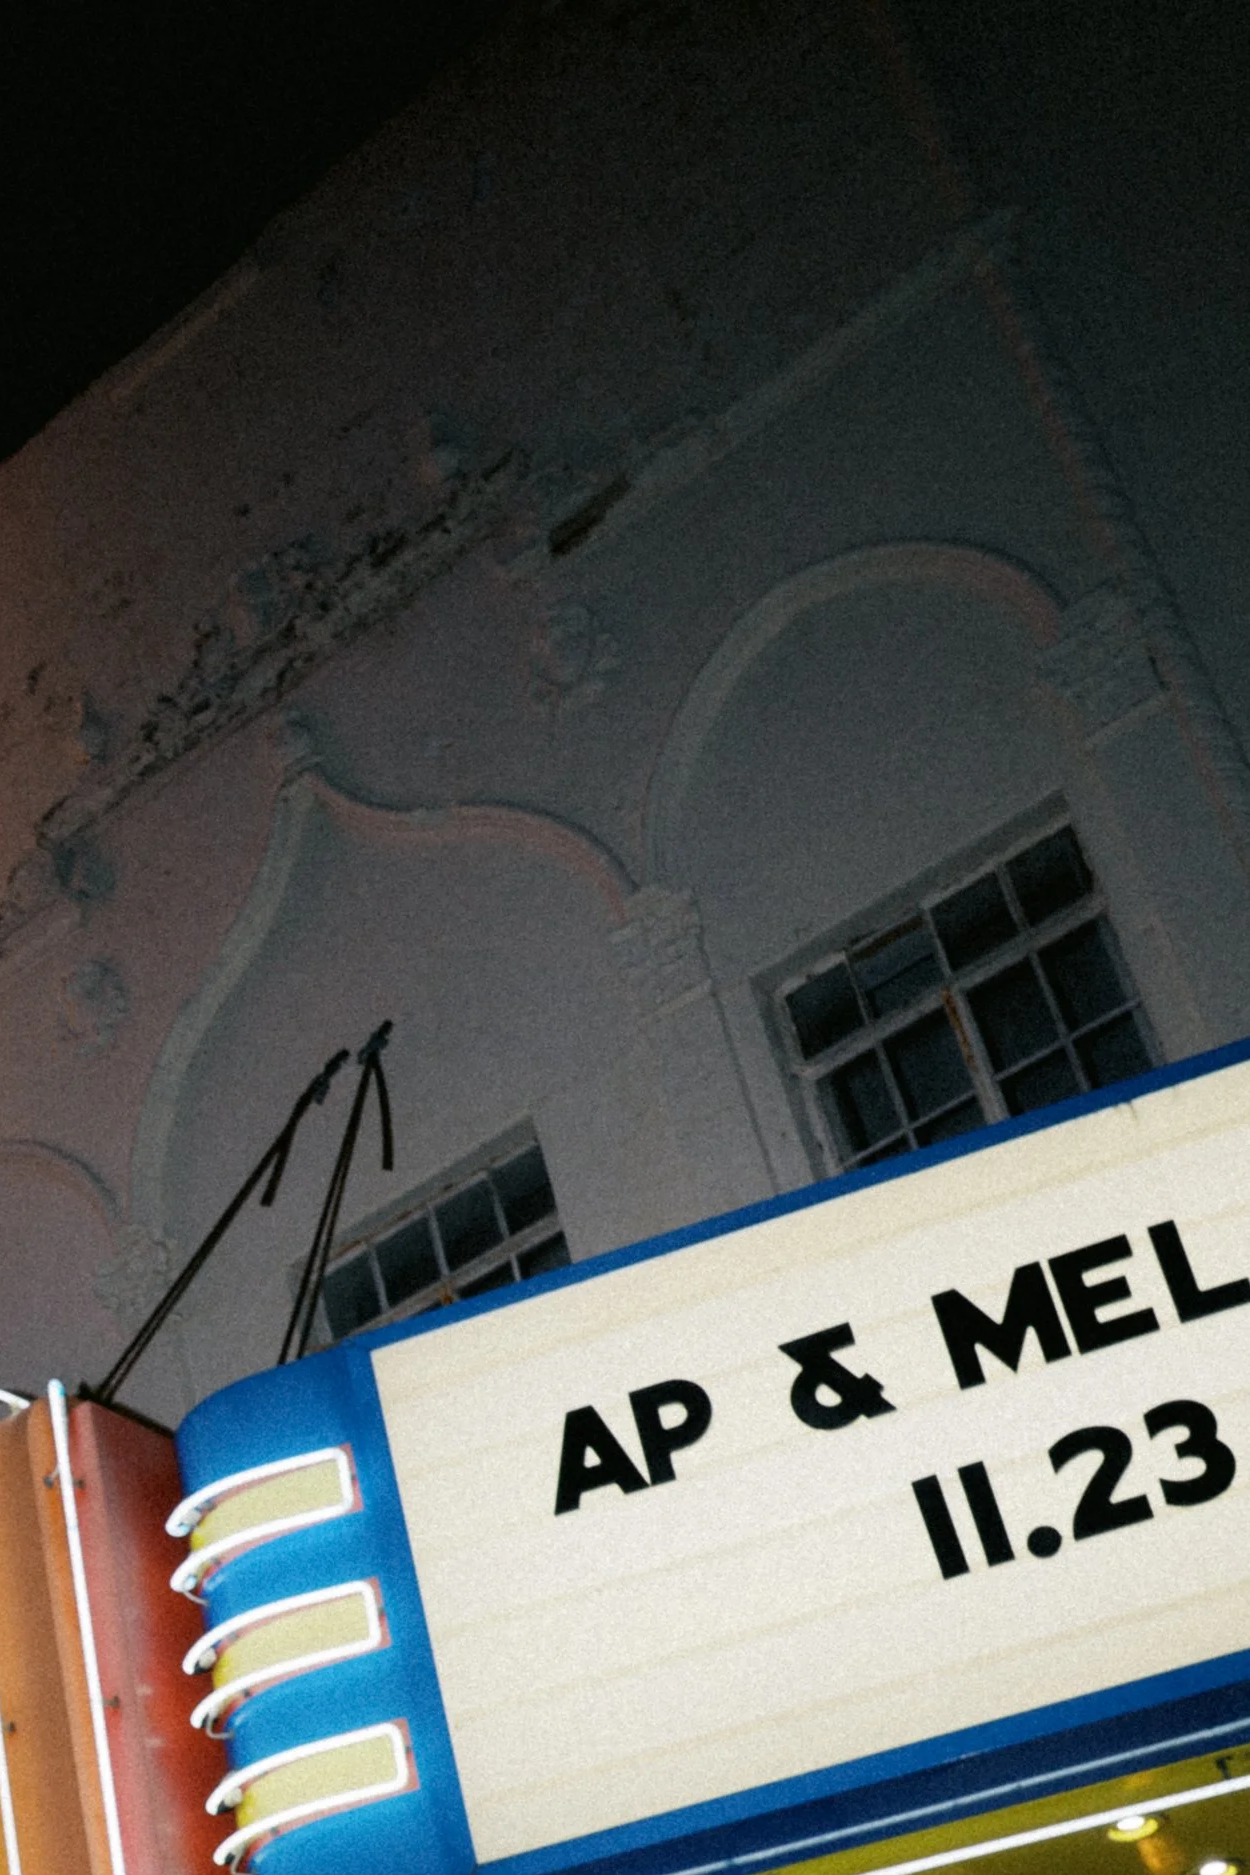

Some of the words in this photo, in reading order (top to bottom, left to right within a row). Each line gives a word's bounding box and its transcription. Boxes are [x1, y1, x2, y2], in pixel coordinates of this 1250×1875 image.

[554, 1379, 713, 1516] AP
[778, 1322, 896, 1430] &
[931, 1220, 1250, 1390] MEL
[911, 1400, 1236, 1580] 11.23
